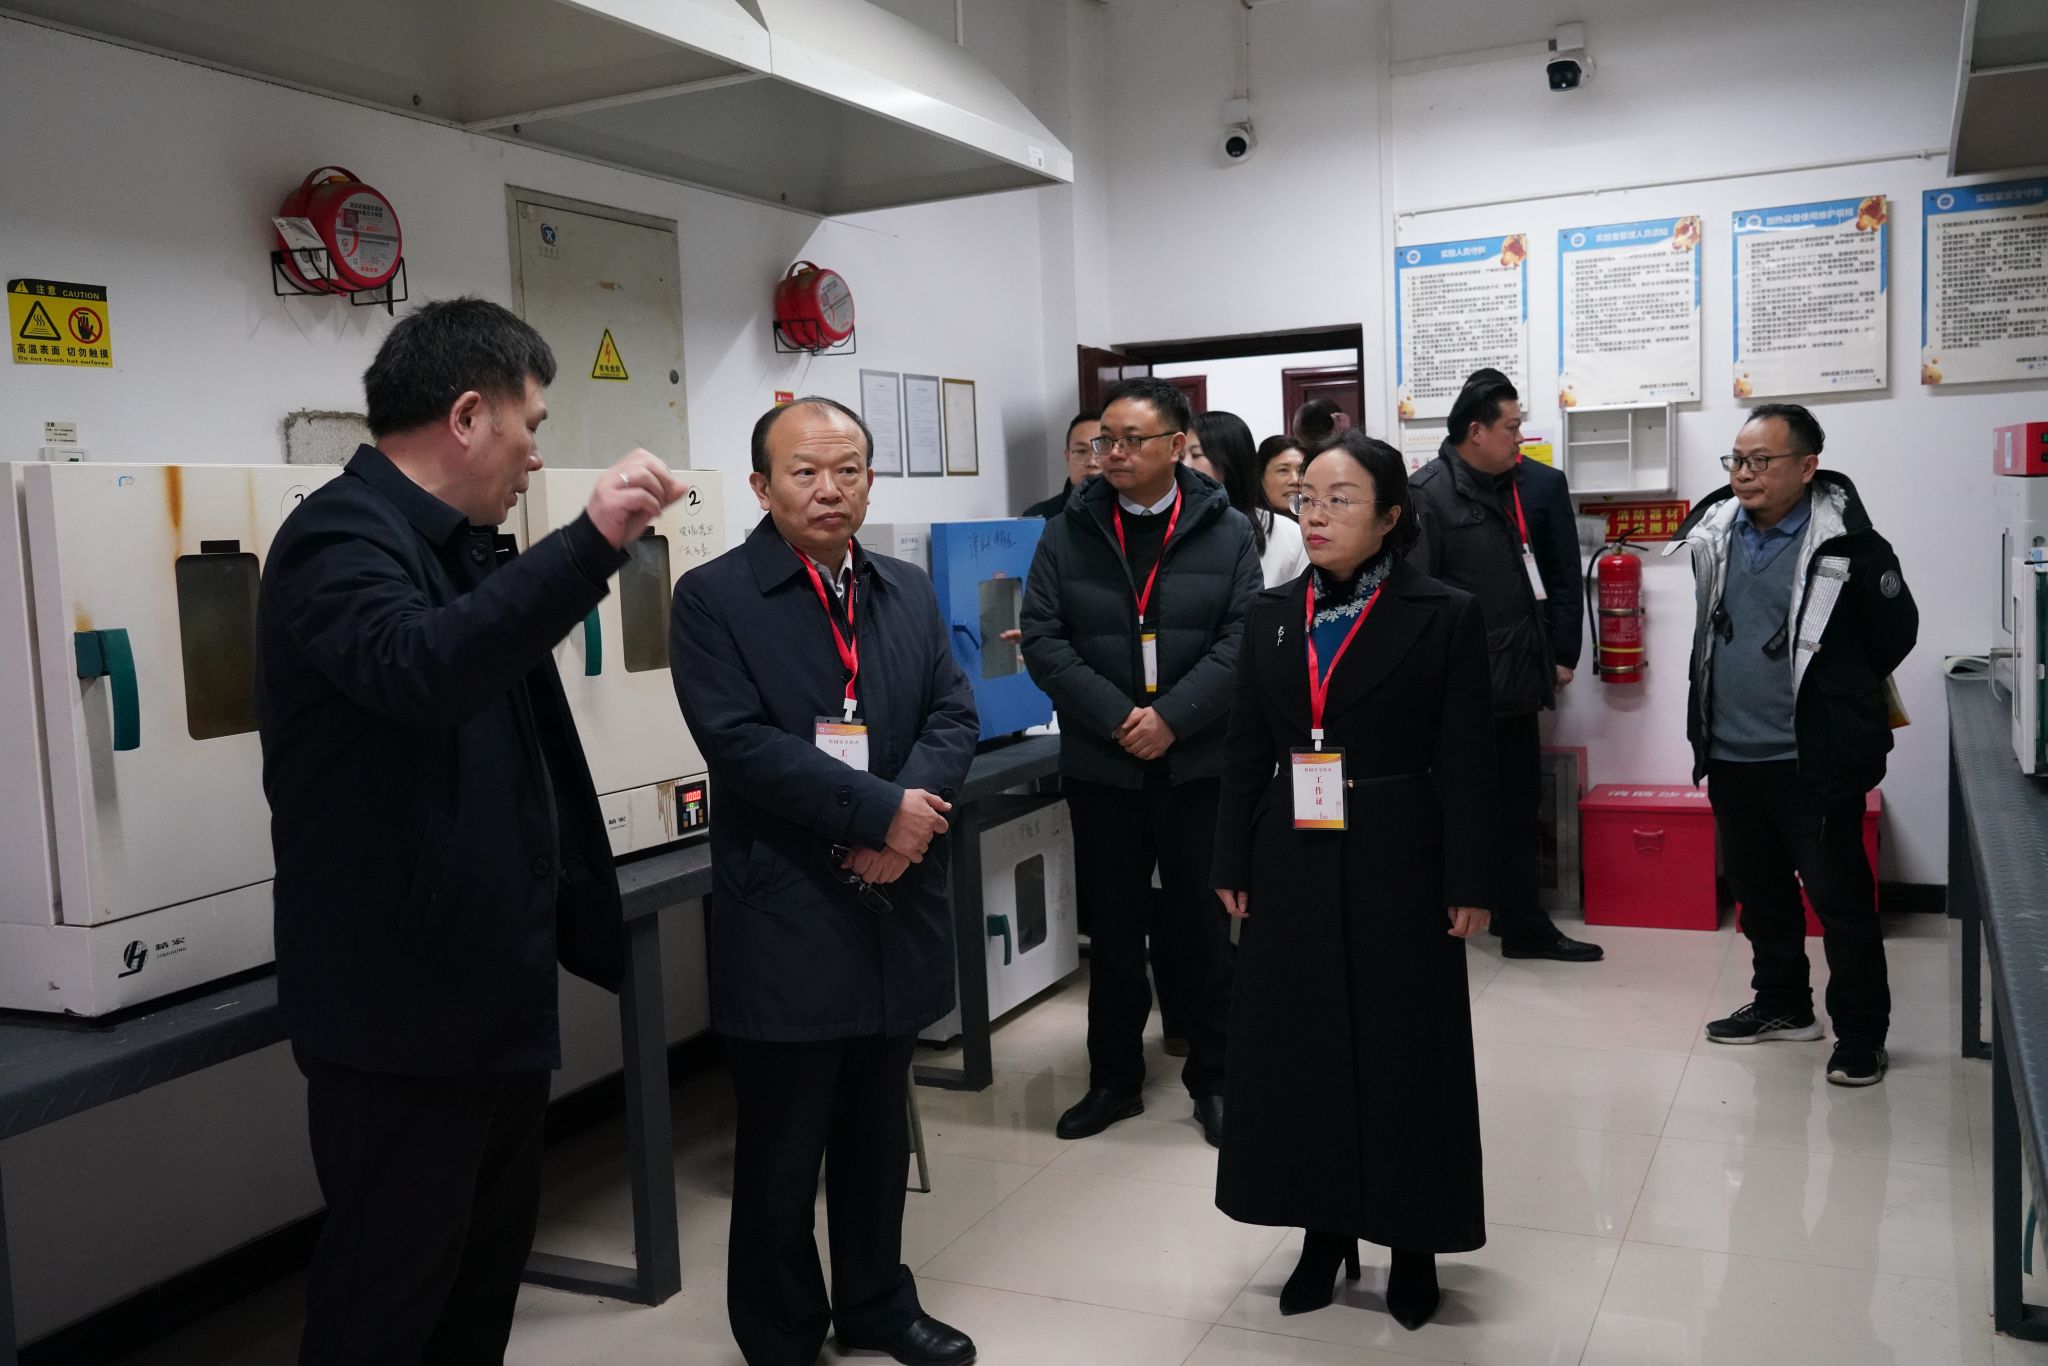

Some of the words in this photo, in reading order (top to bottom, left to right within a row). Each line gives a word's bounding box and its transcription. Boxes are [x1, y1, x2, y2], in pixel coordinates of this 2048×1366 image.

[36, 284, 57, 296] 注意
[62, 289, 100, 300] CAUTION
[16, 343, 60, 355] 高温表面
[67, 346, 109, 358] 切勿触摸
[688, 490, 701, 506] 2
[1617, 508, 1680, 522] 消防器材
[1617, 522, 1679, 534] 严禁挪用
[1607, 790, 1707, 799] 消防沙箱
